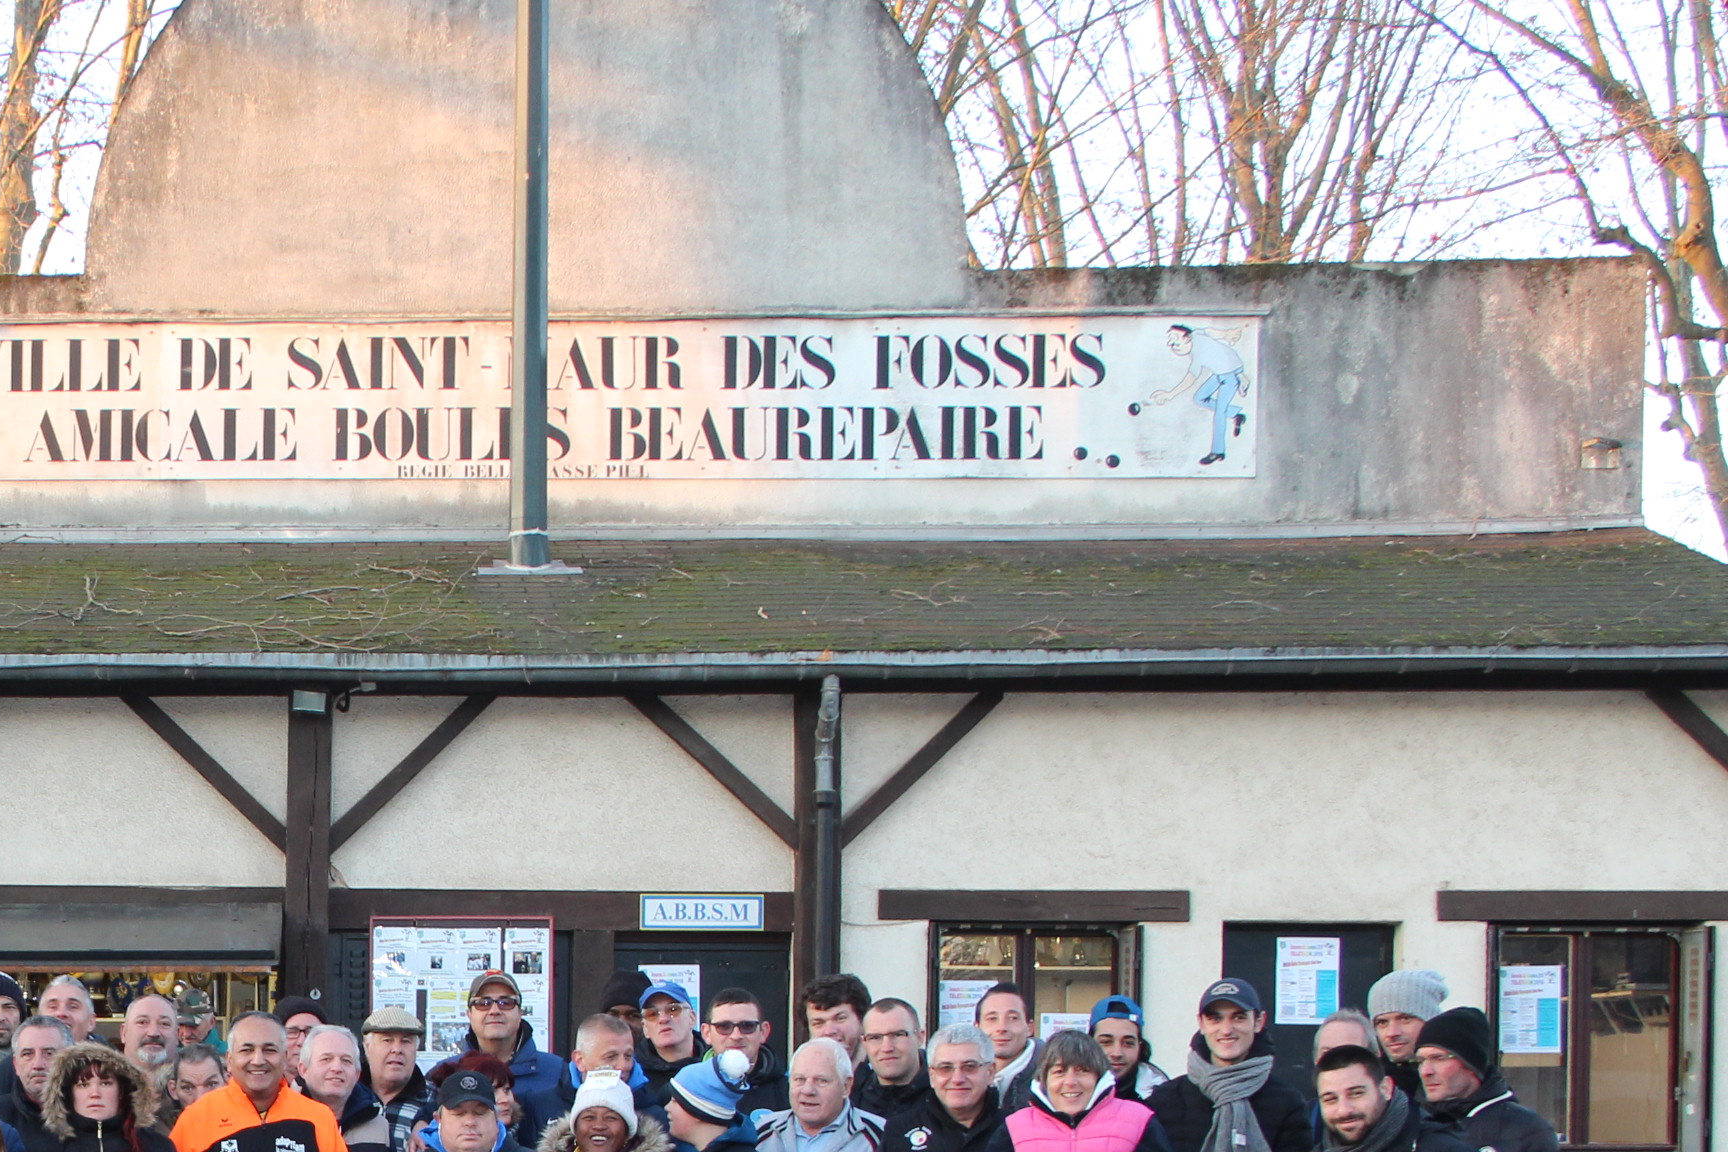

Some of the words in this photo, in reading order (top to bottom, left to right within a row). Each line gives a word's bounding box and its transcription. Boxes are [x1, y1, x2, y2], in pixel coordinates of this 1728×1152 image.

[177, 337, 253, 392] DE
[720, 336, 836, 390] DES
[873, 334, 1106, 389] FOSSES
[23, 408, 297, 463] AMICALE
[607, 405, 1044, 462] BEAUREPAIRE
[398, 464, 452, 478] REGIE
